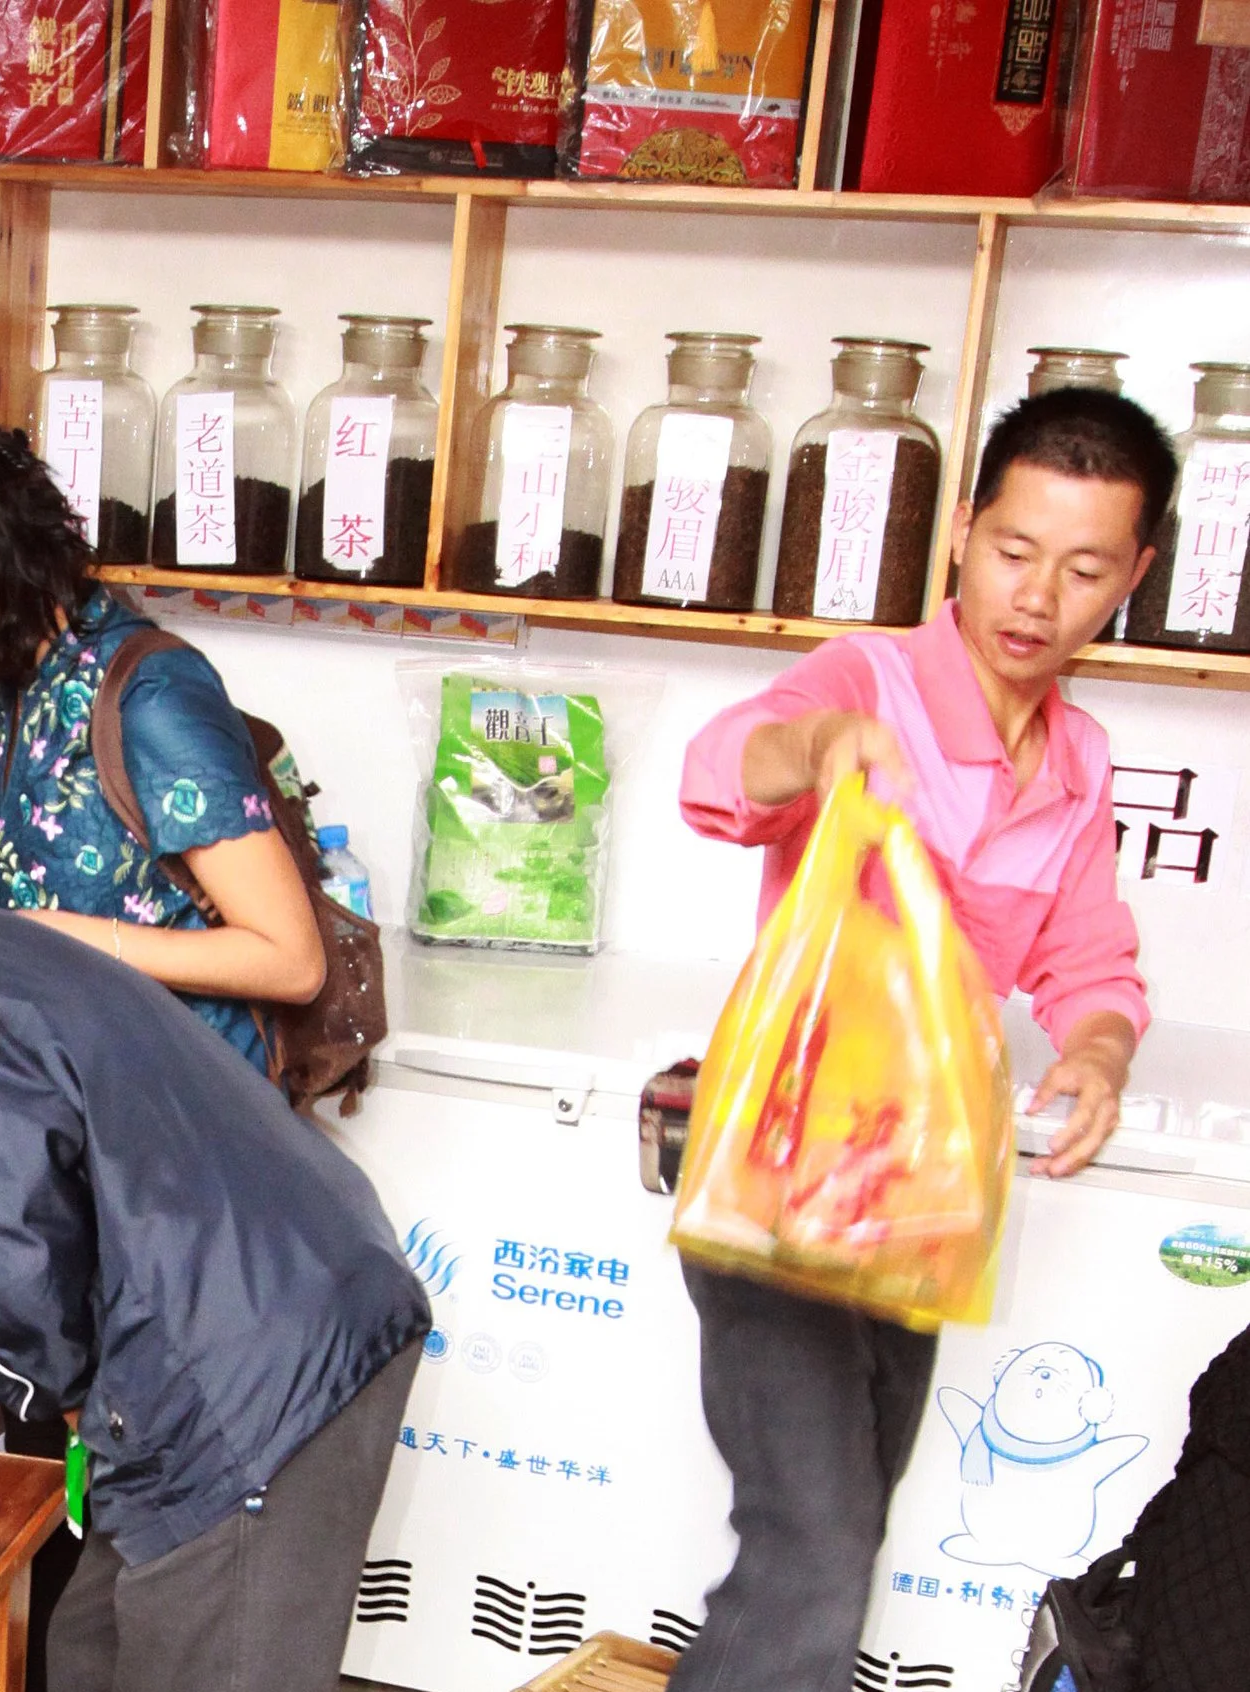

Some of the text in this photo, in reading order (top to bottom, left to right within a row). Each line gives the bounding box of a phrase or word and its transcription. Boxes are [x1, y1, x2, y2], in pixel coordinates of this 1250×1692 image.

[183, 411, 226, 546] 老道茶
[330, 414, 382, 560] 红茶
[656, 567, 696, 592] AAA
[485, 708, 557, 747] 觀音王
[491, 1272, 625, 1320] Serene
